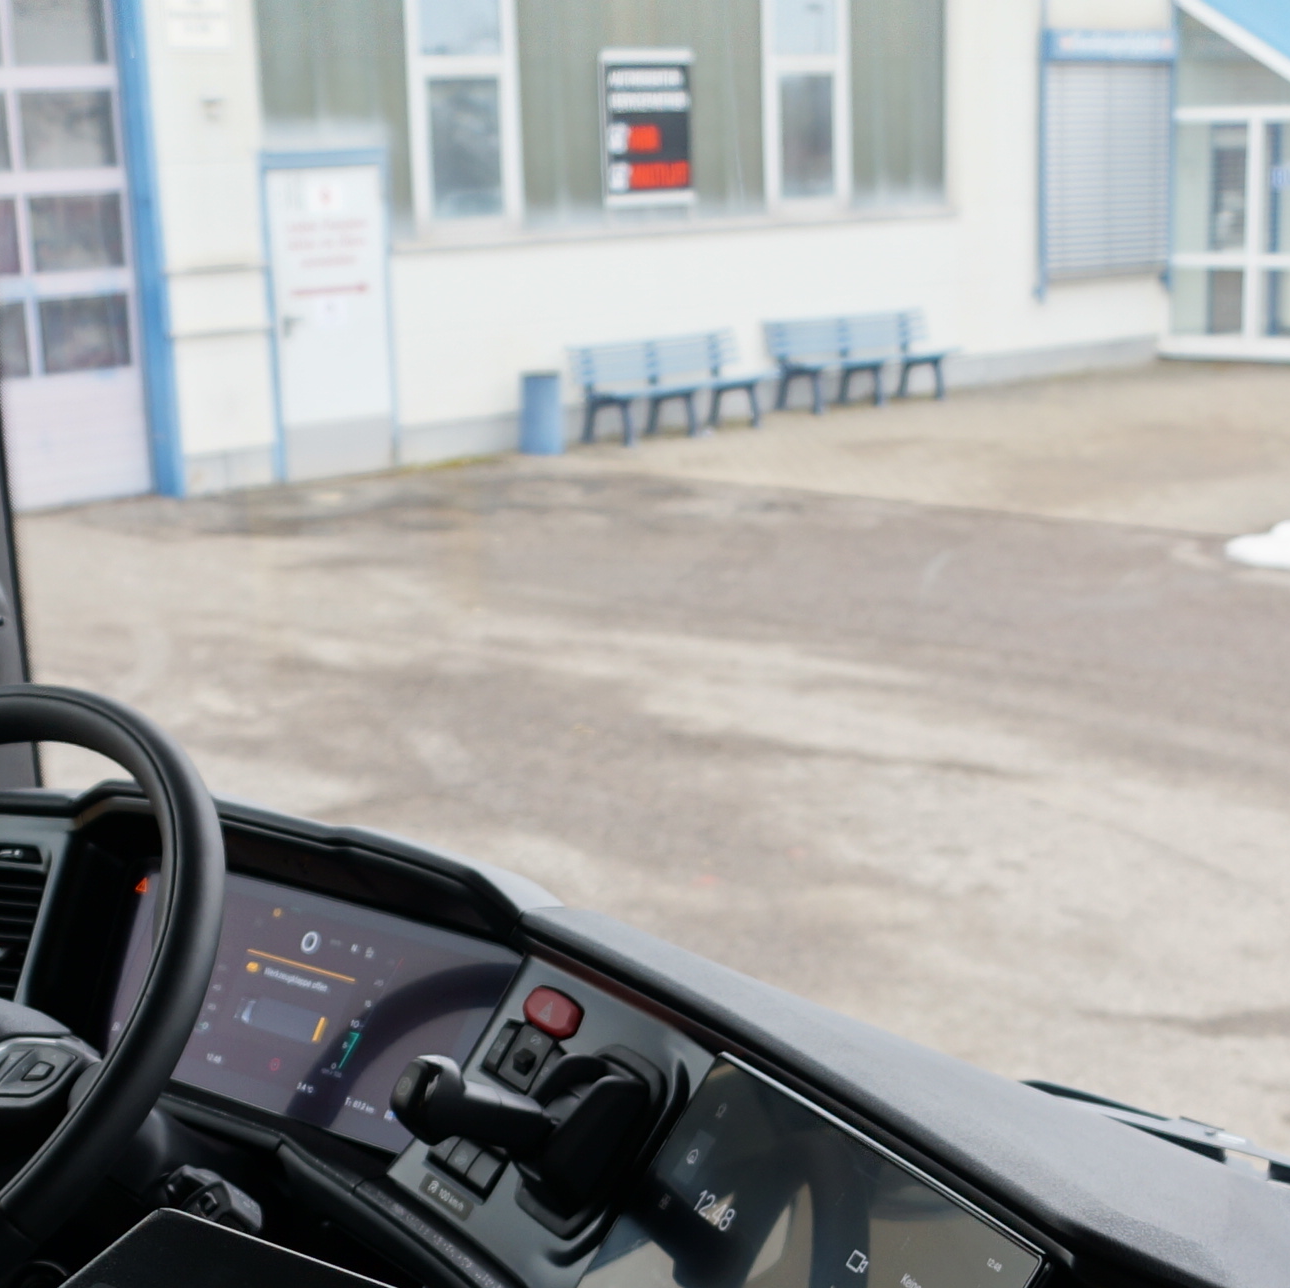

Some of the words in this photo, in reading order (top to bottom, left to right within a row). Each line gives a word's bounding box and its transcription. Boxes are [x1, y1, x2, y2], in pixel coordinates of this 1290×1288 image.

[301, 931, 320, 954] 0
[350, 1019, 361, 1029] 10
[693, 1189, 737, 1232] 12:48
